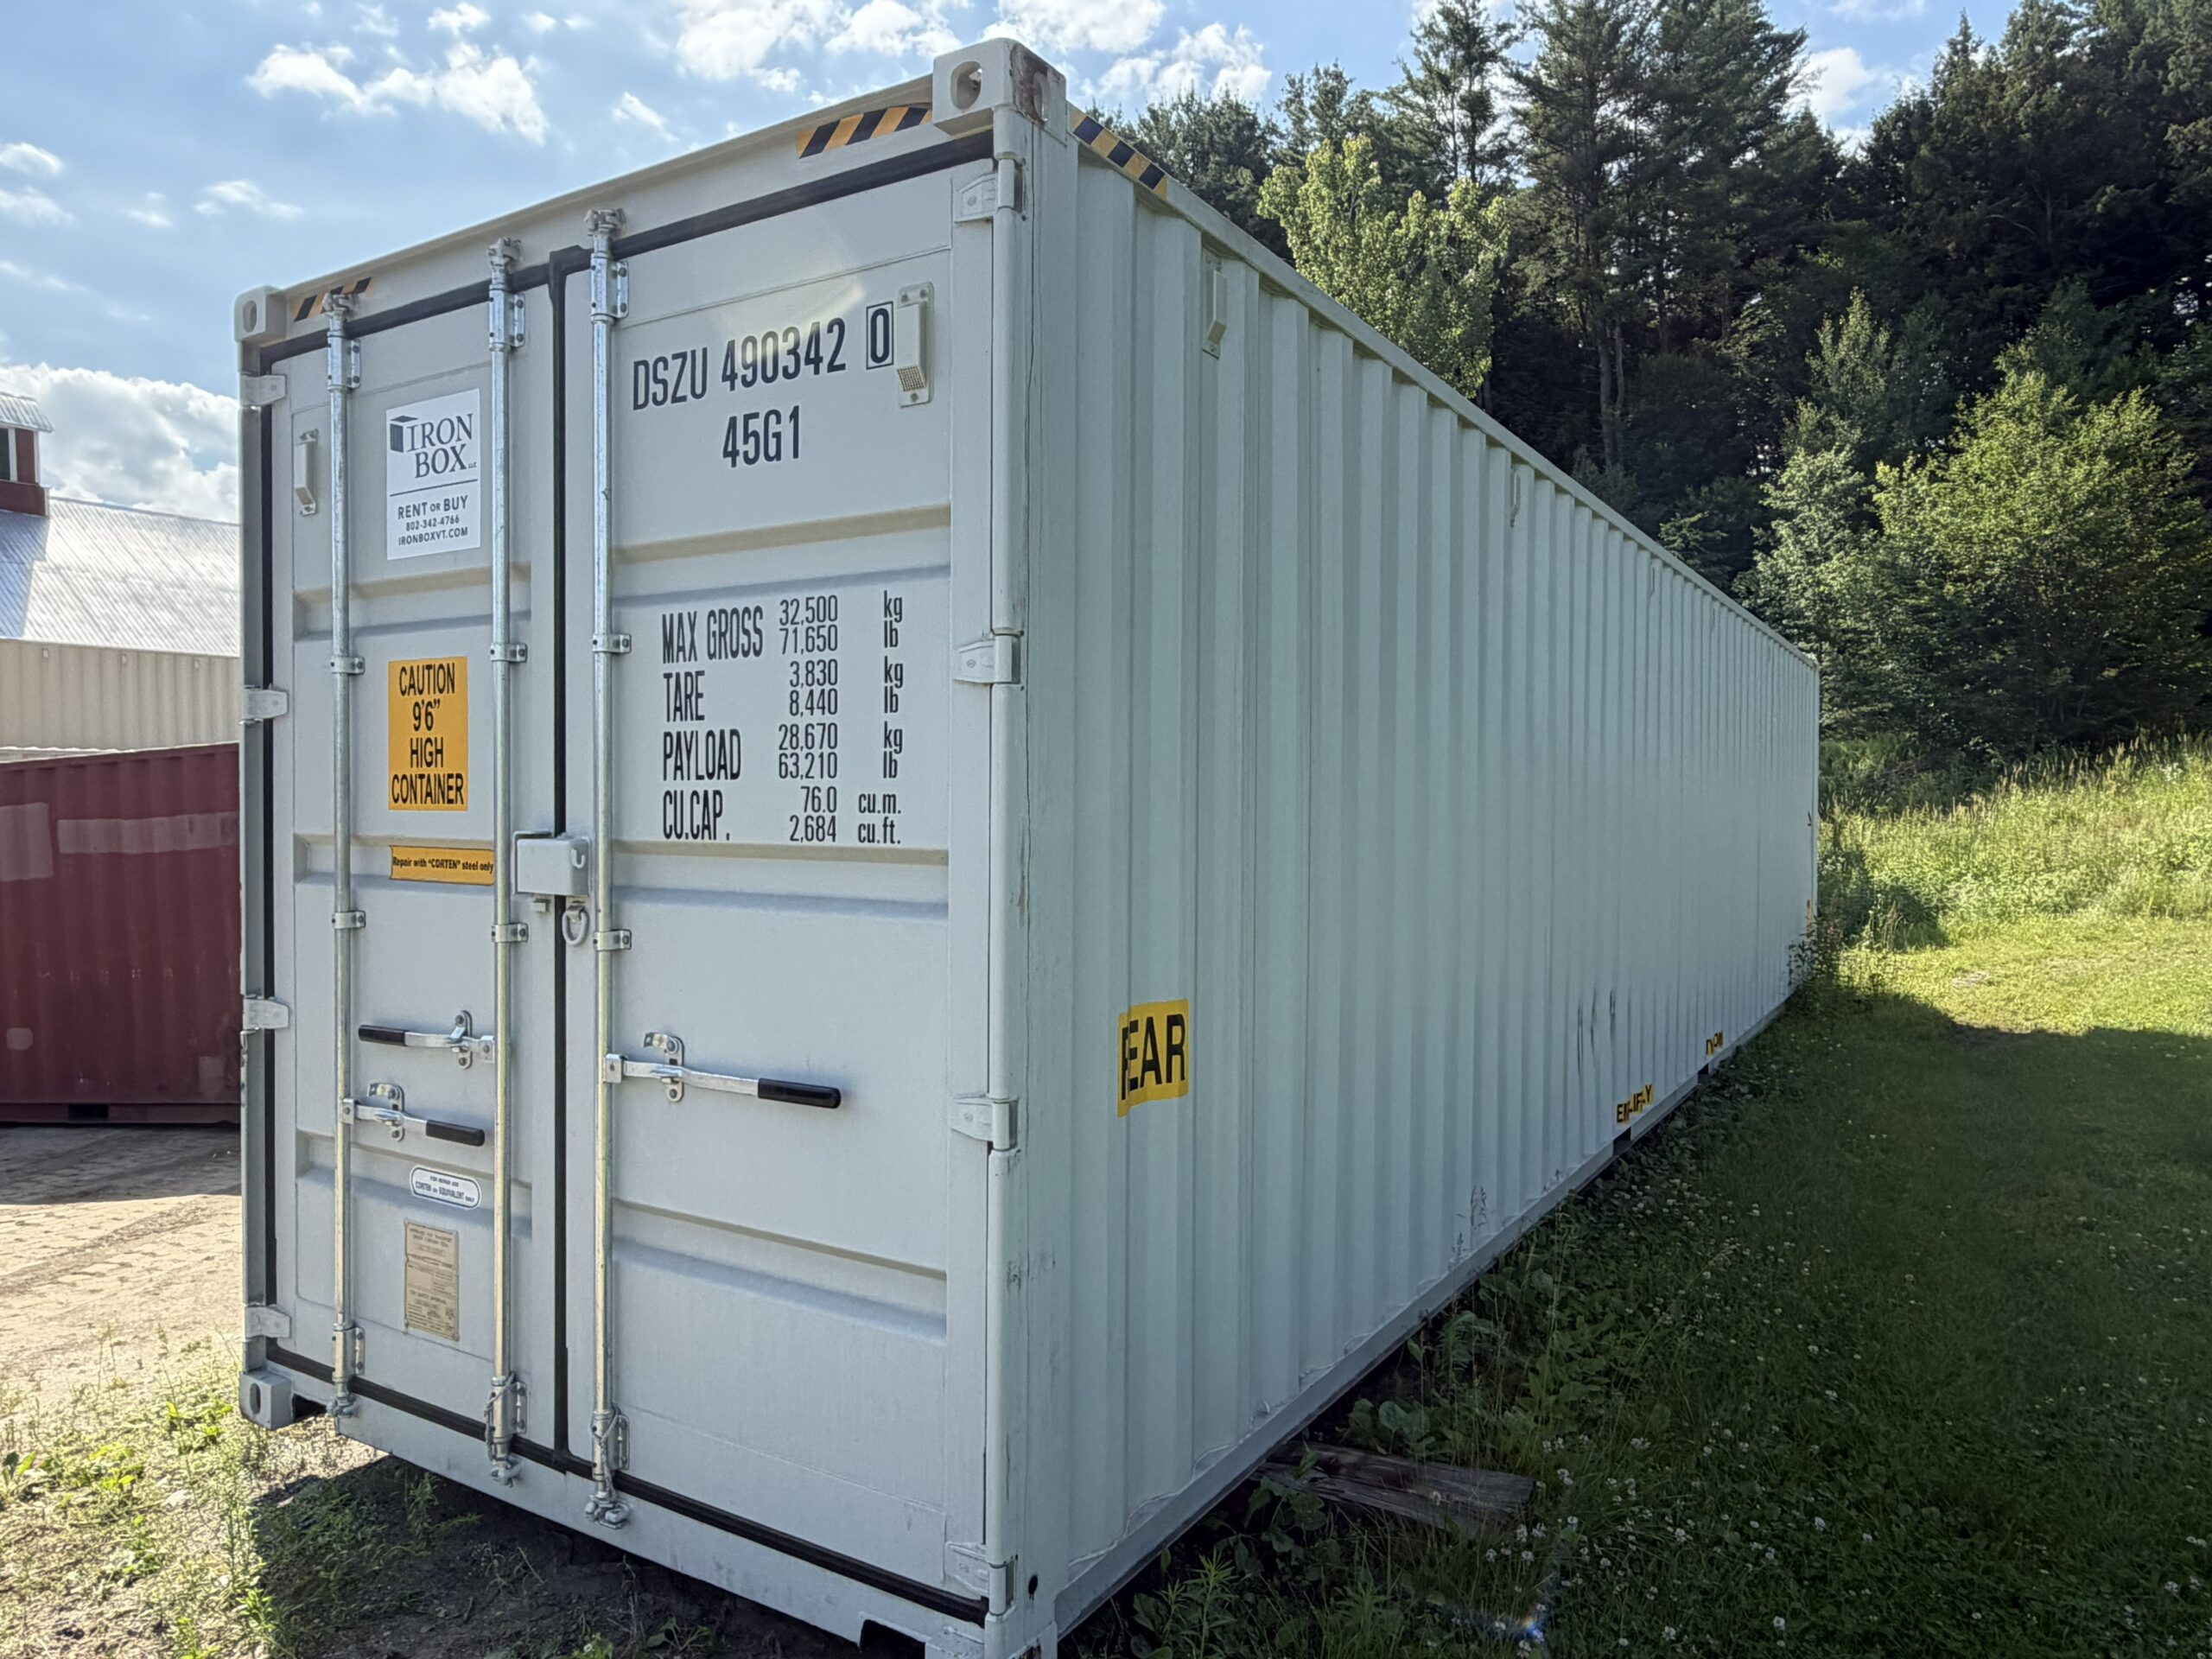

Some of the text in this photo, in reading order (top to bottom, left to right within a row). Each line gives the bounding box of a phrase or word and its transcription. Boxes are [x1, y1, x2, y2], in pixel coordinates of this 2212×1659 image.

[632, 307, 890, 410] DSZU 490342 0
[406, 413, 474, 453] IRON
[722, 404, 800, 468] 45G1
[414, 443, 467, 479] BOX
[397, 494, 468, 520] RENT OR BUY
[405, 513, 460, 532] 802-342-4766
[397, 526, 469, 547] IRONBOXVT.COM
[662, 589, 903, 664] MAX GROSS 32,500 kg
[779, 620, 899, 655] 71,650 lb
[398, 662, 455, 696] CAUTION
[663, 655, 904, 722] TARE 3,830 kg
[789, 685, 899, 718] 8,440 lb
[410, 736, 444, 768] HIGH
[663, 721, 904, 781] PAYLOAD 28,670 kg
[778, 750, 899, 781] 63,210 lb
[391, 772, 465, 805] CONTAINER
[663, 785, 902, 841] CU.CAP. 76.0 cu.m.
[789, 814, 901, 845] 2,684 cu.ft.
[392, 856, 412, 868] Repair
[413, 857, 428, 868] with
[461, 860, 479, 871] steel
[480, 861, 494, 874] only
